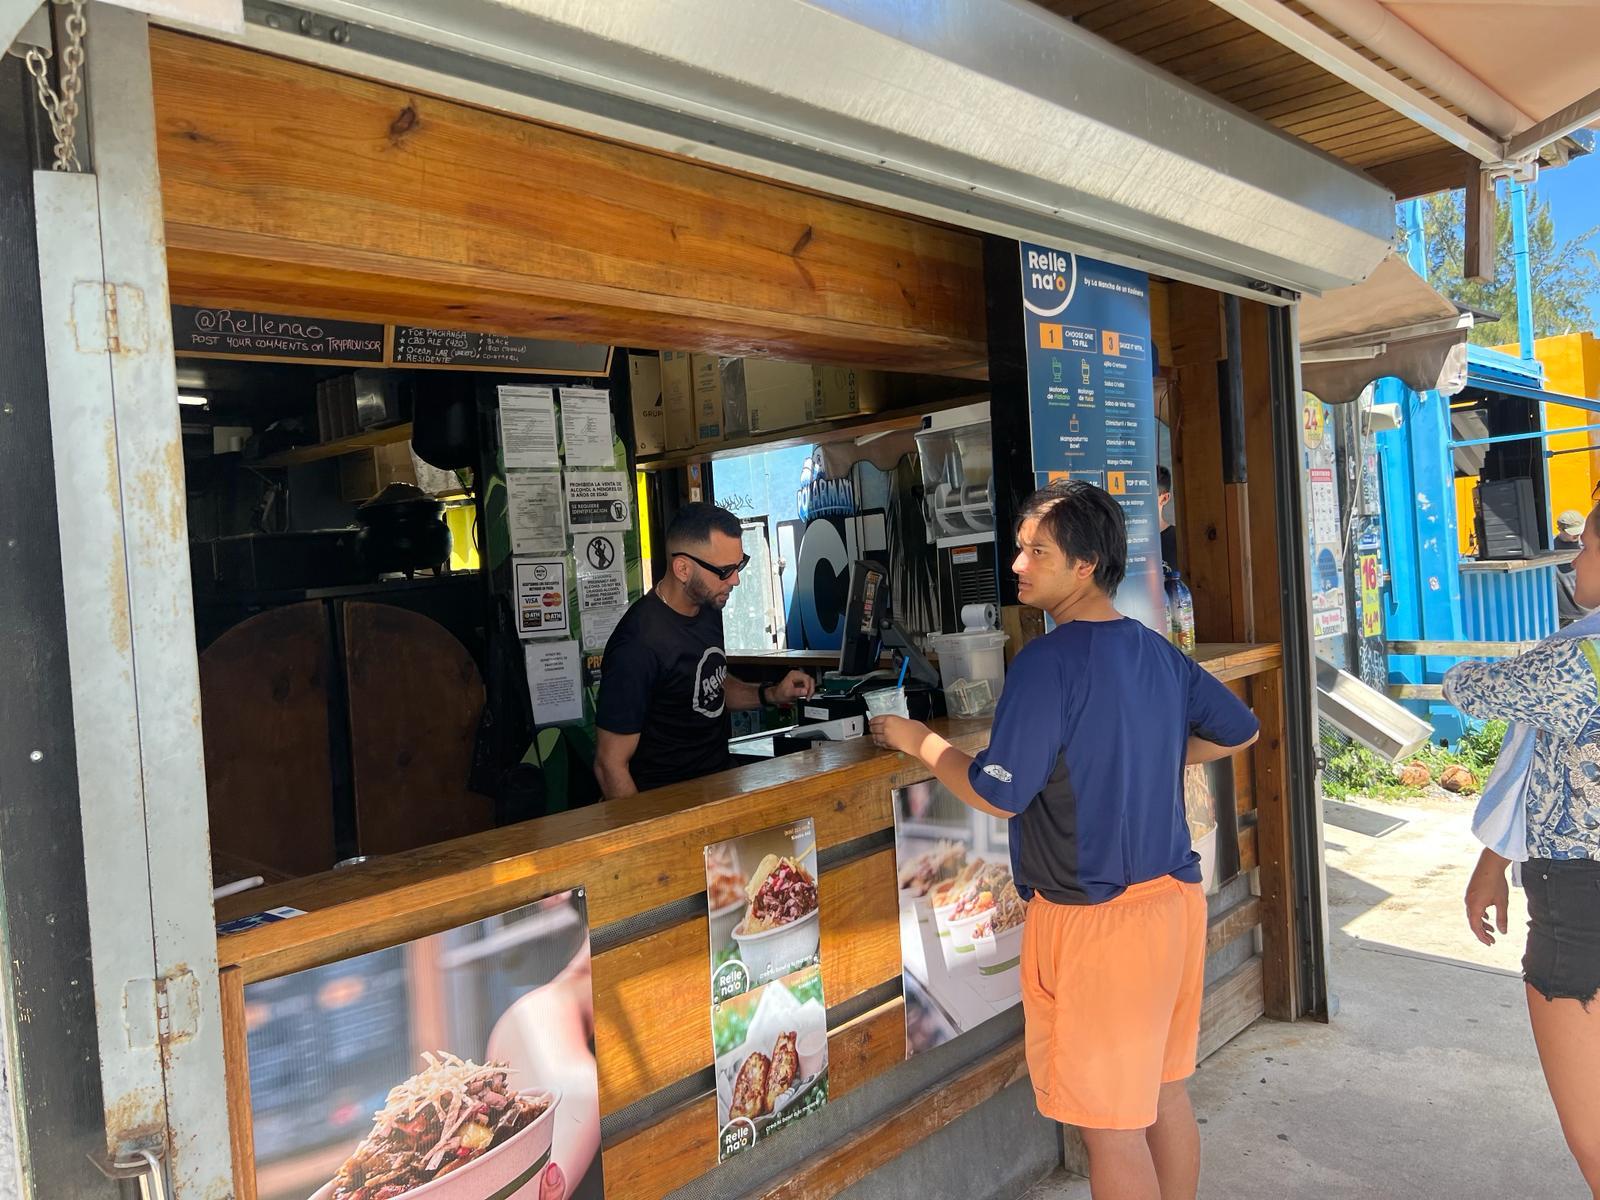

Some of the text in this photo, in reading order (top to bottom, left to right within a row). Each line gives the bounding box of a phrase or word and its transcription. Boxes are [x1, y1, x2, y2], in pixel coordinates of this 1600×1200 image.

[1028, 250, 1066, 272] Relle
[1032, 272, 1066, 292] na'o
[1084, 277, 1090, 286] by
[195, 310, 323, 338] @Rellenao
[192, 334, 219, 345] POST
[226, 336, 252, 348] YOUR
[256, 340, 309, 350] COMMENTS
[487, 338, 509, 346] BLACK
[1049, 329, 1054, 344] 1
[1065, 330, 1094, 340] CHOOSE ONE
[1108, 337, 1113, 350] 3
[406, 354, 451, 364] RESIDENTE
[1303, 407, 1318, 430] 24
[1114, 477, 1118, 490] 4
[1363, 558, 1376, 590] 16
[720, 970, 742, 986] Relle
[725, 1127, 748, 1145] Relle
[726, 1138, 747, 1154] na'o
